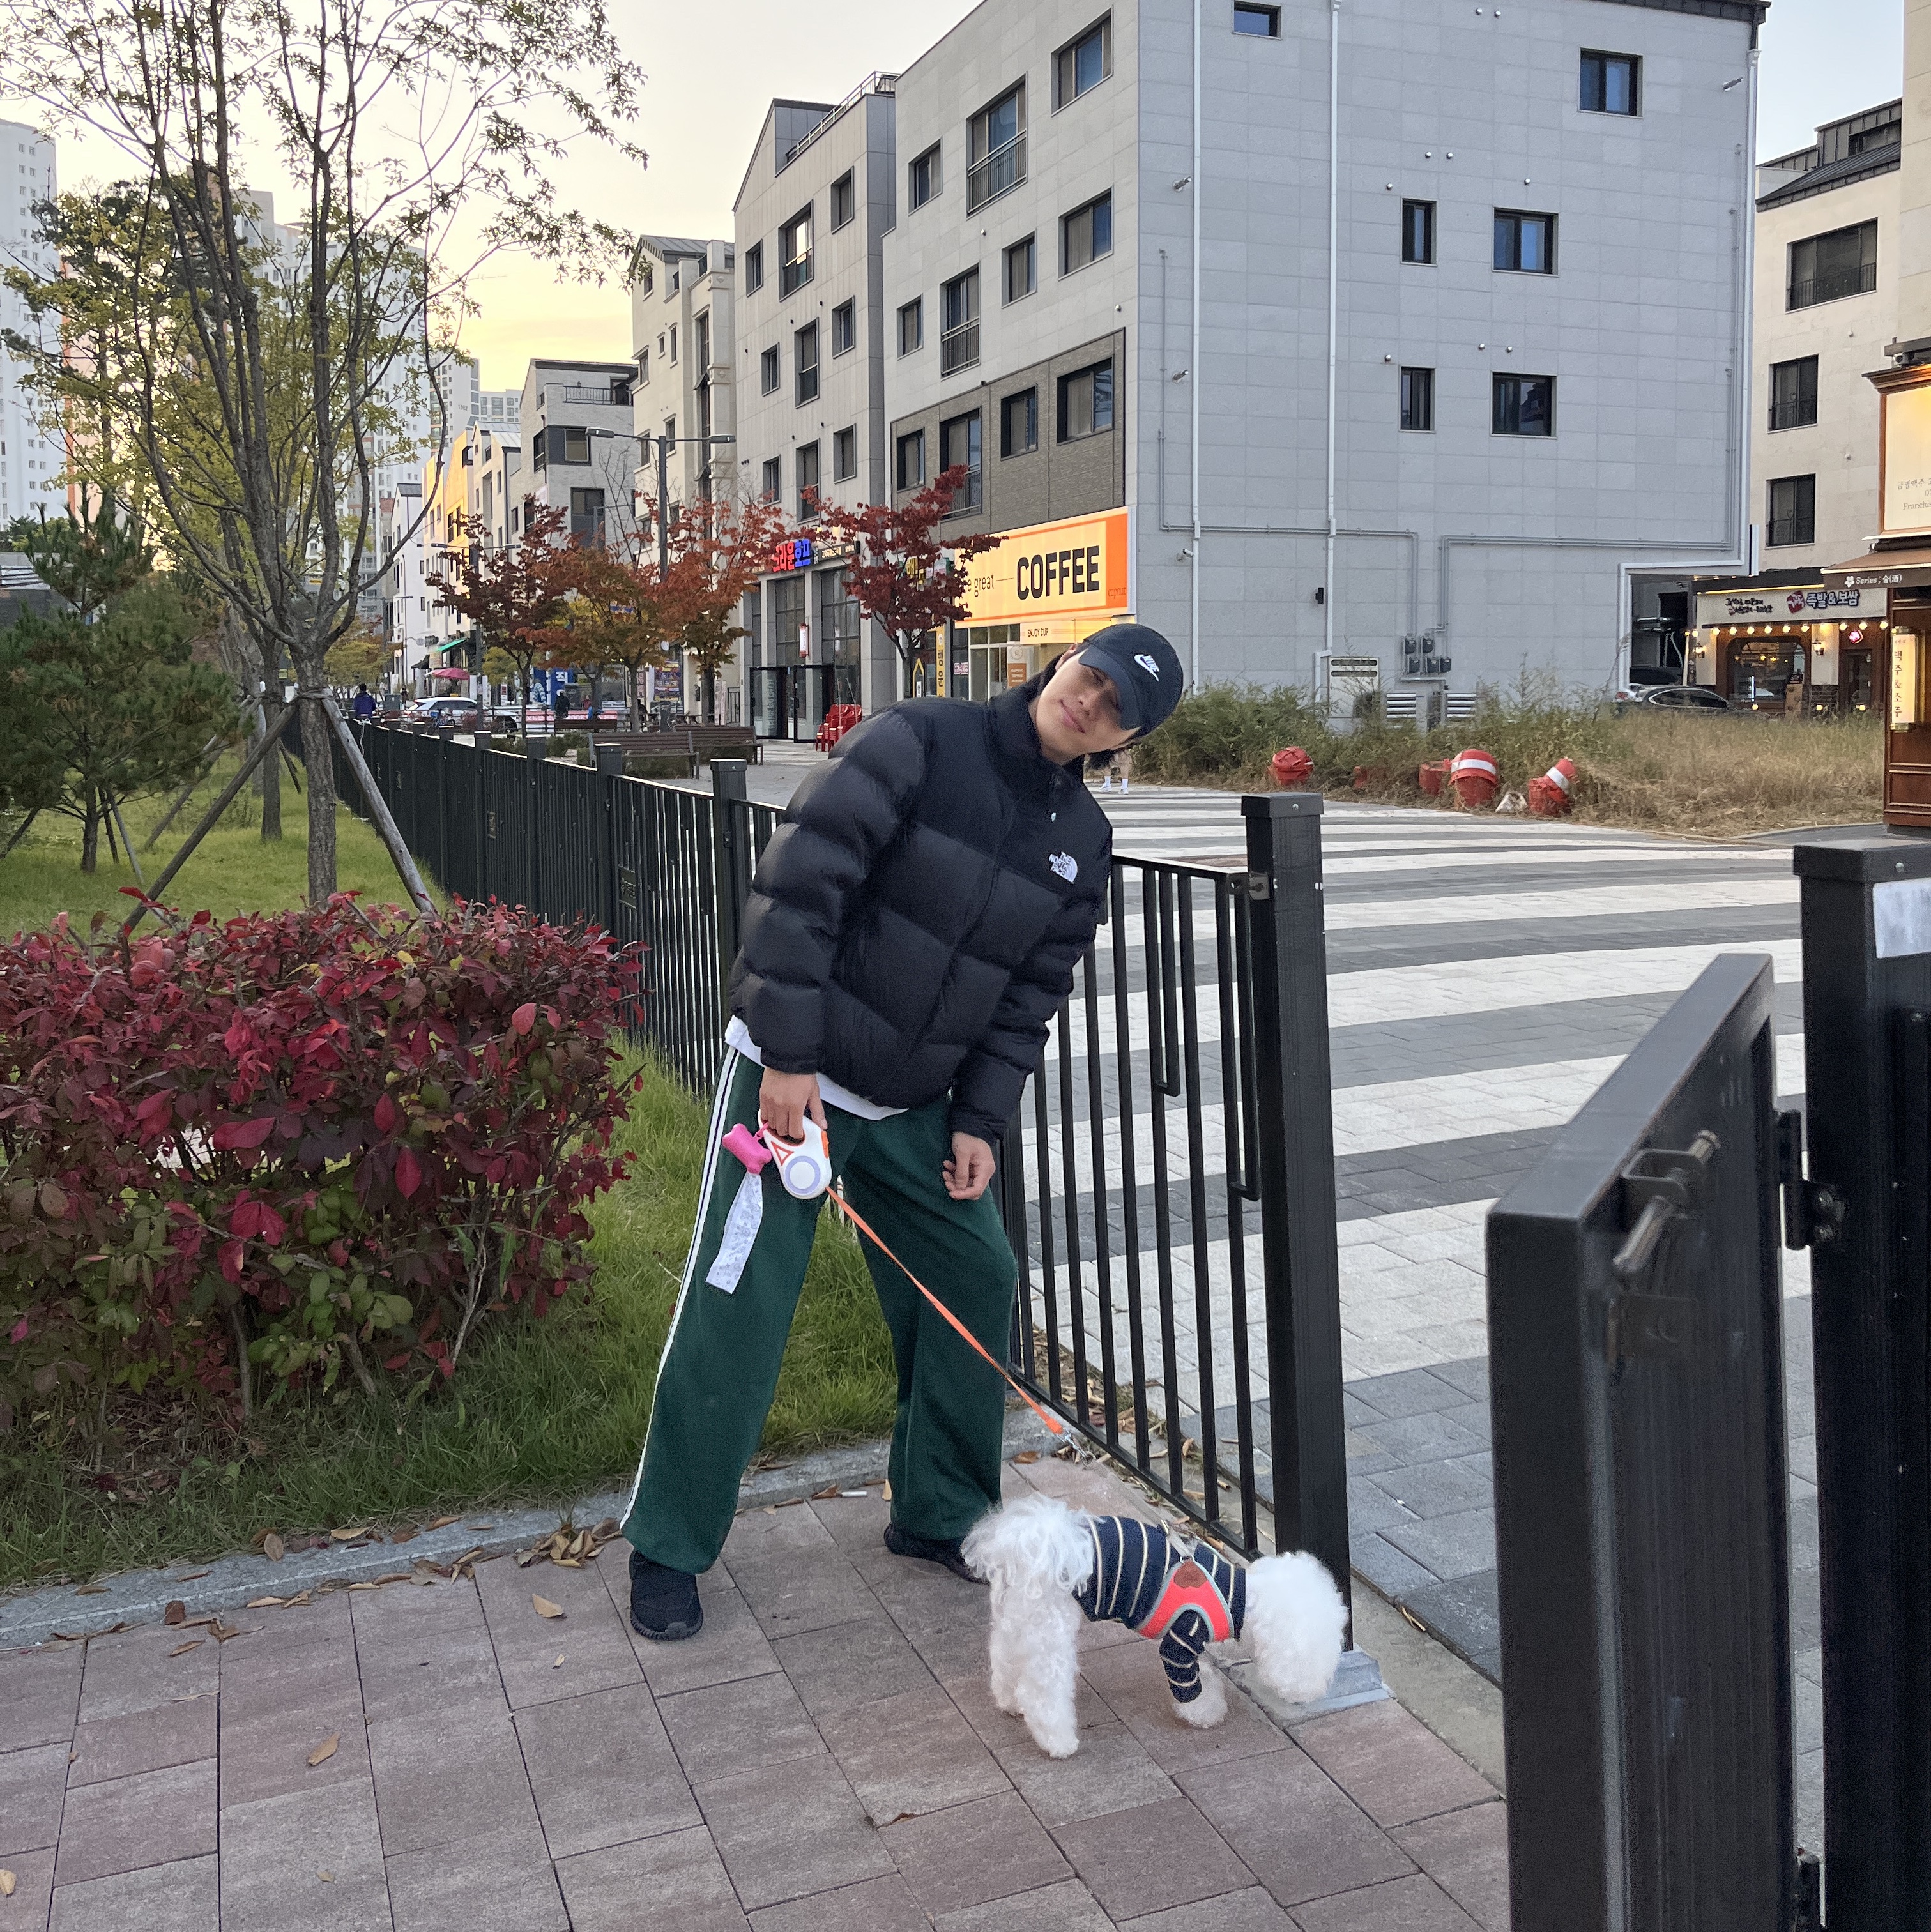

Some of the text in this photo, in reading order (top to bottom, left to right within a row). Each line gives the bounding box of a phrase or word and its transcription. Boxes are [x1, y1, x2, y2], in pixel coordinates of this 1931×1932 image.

[974, 575, 995, 597] great
[1017, 545, 1099, 600] COFFEE
[1806, 589, 1859, 609] 족발&보쌈
[1041, 628, 1049, 636] CUP
